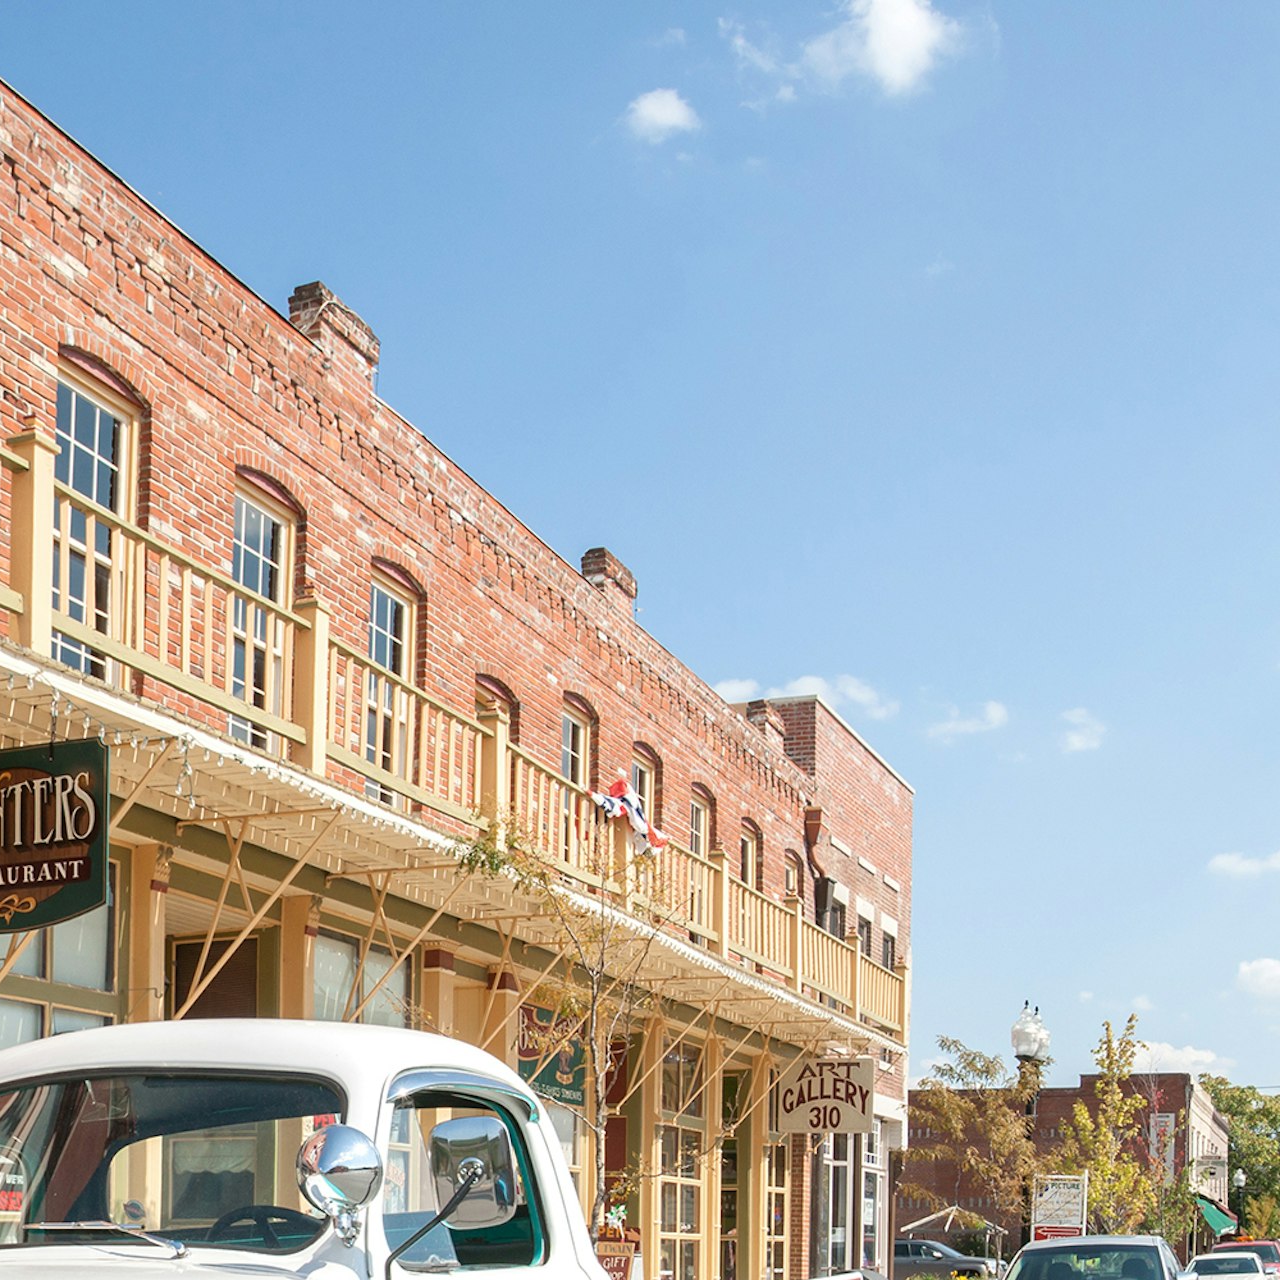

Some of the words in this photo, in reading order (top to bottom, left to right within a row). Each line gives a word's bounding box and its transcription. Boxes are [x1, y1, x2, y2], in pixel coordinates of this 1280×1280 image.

[796, 1062, 861, 1083] ART
[782, 1077, 870, 1116] GALLERY
[809, 1104, 841, 1129] 310
[598, 1226, 628, 1238] PEN
[602, 1256, 627, 1269] GIFT
[609, 1271, 627, 1280] OP.
